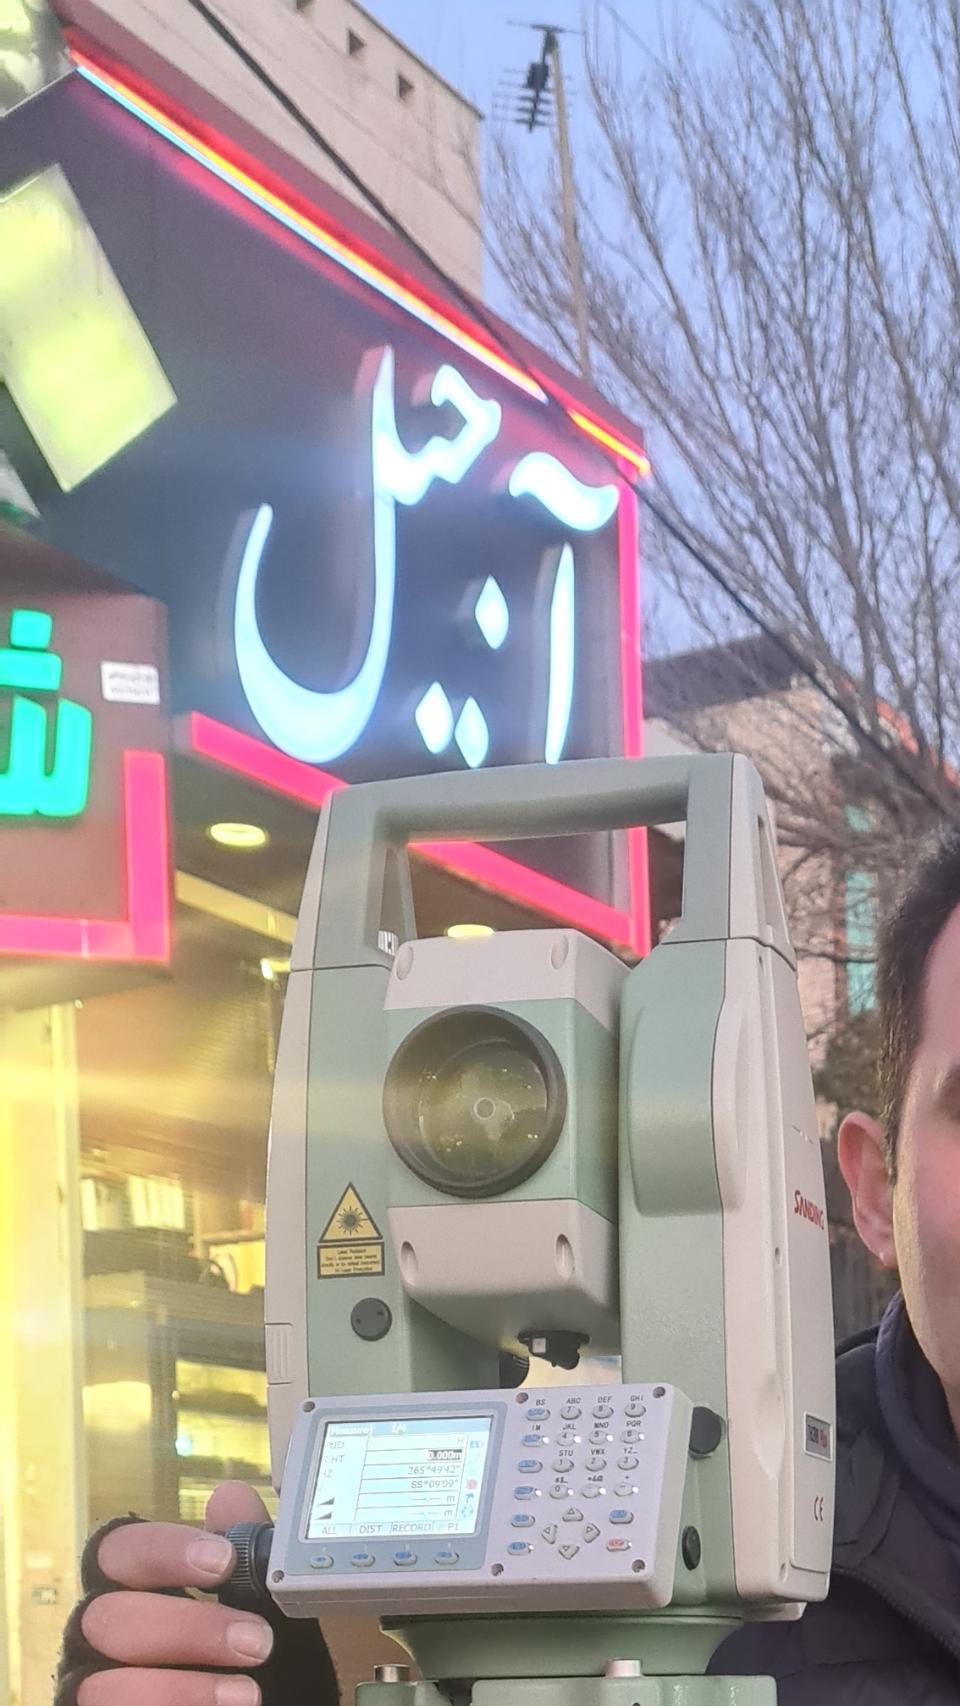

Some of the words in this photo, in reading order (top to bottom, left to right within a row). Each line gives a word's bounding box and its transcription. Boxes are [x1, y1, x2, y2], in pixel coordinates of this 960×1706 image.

[232, 344, 620, 768] آجیل
[597, 1395, 613, 1404] DEF
[629, 1394, 644, 1402] GHI
[558, 1449, 574, 1457] STU
